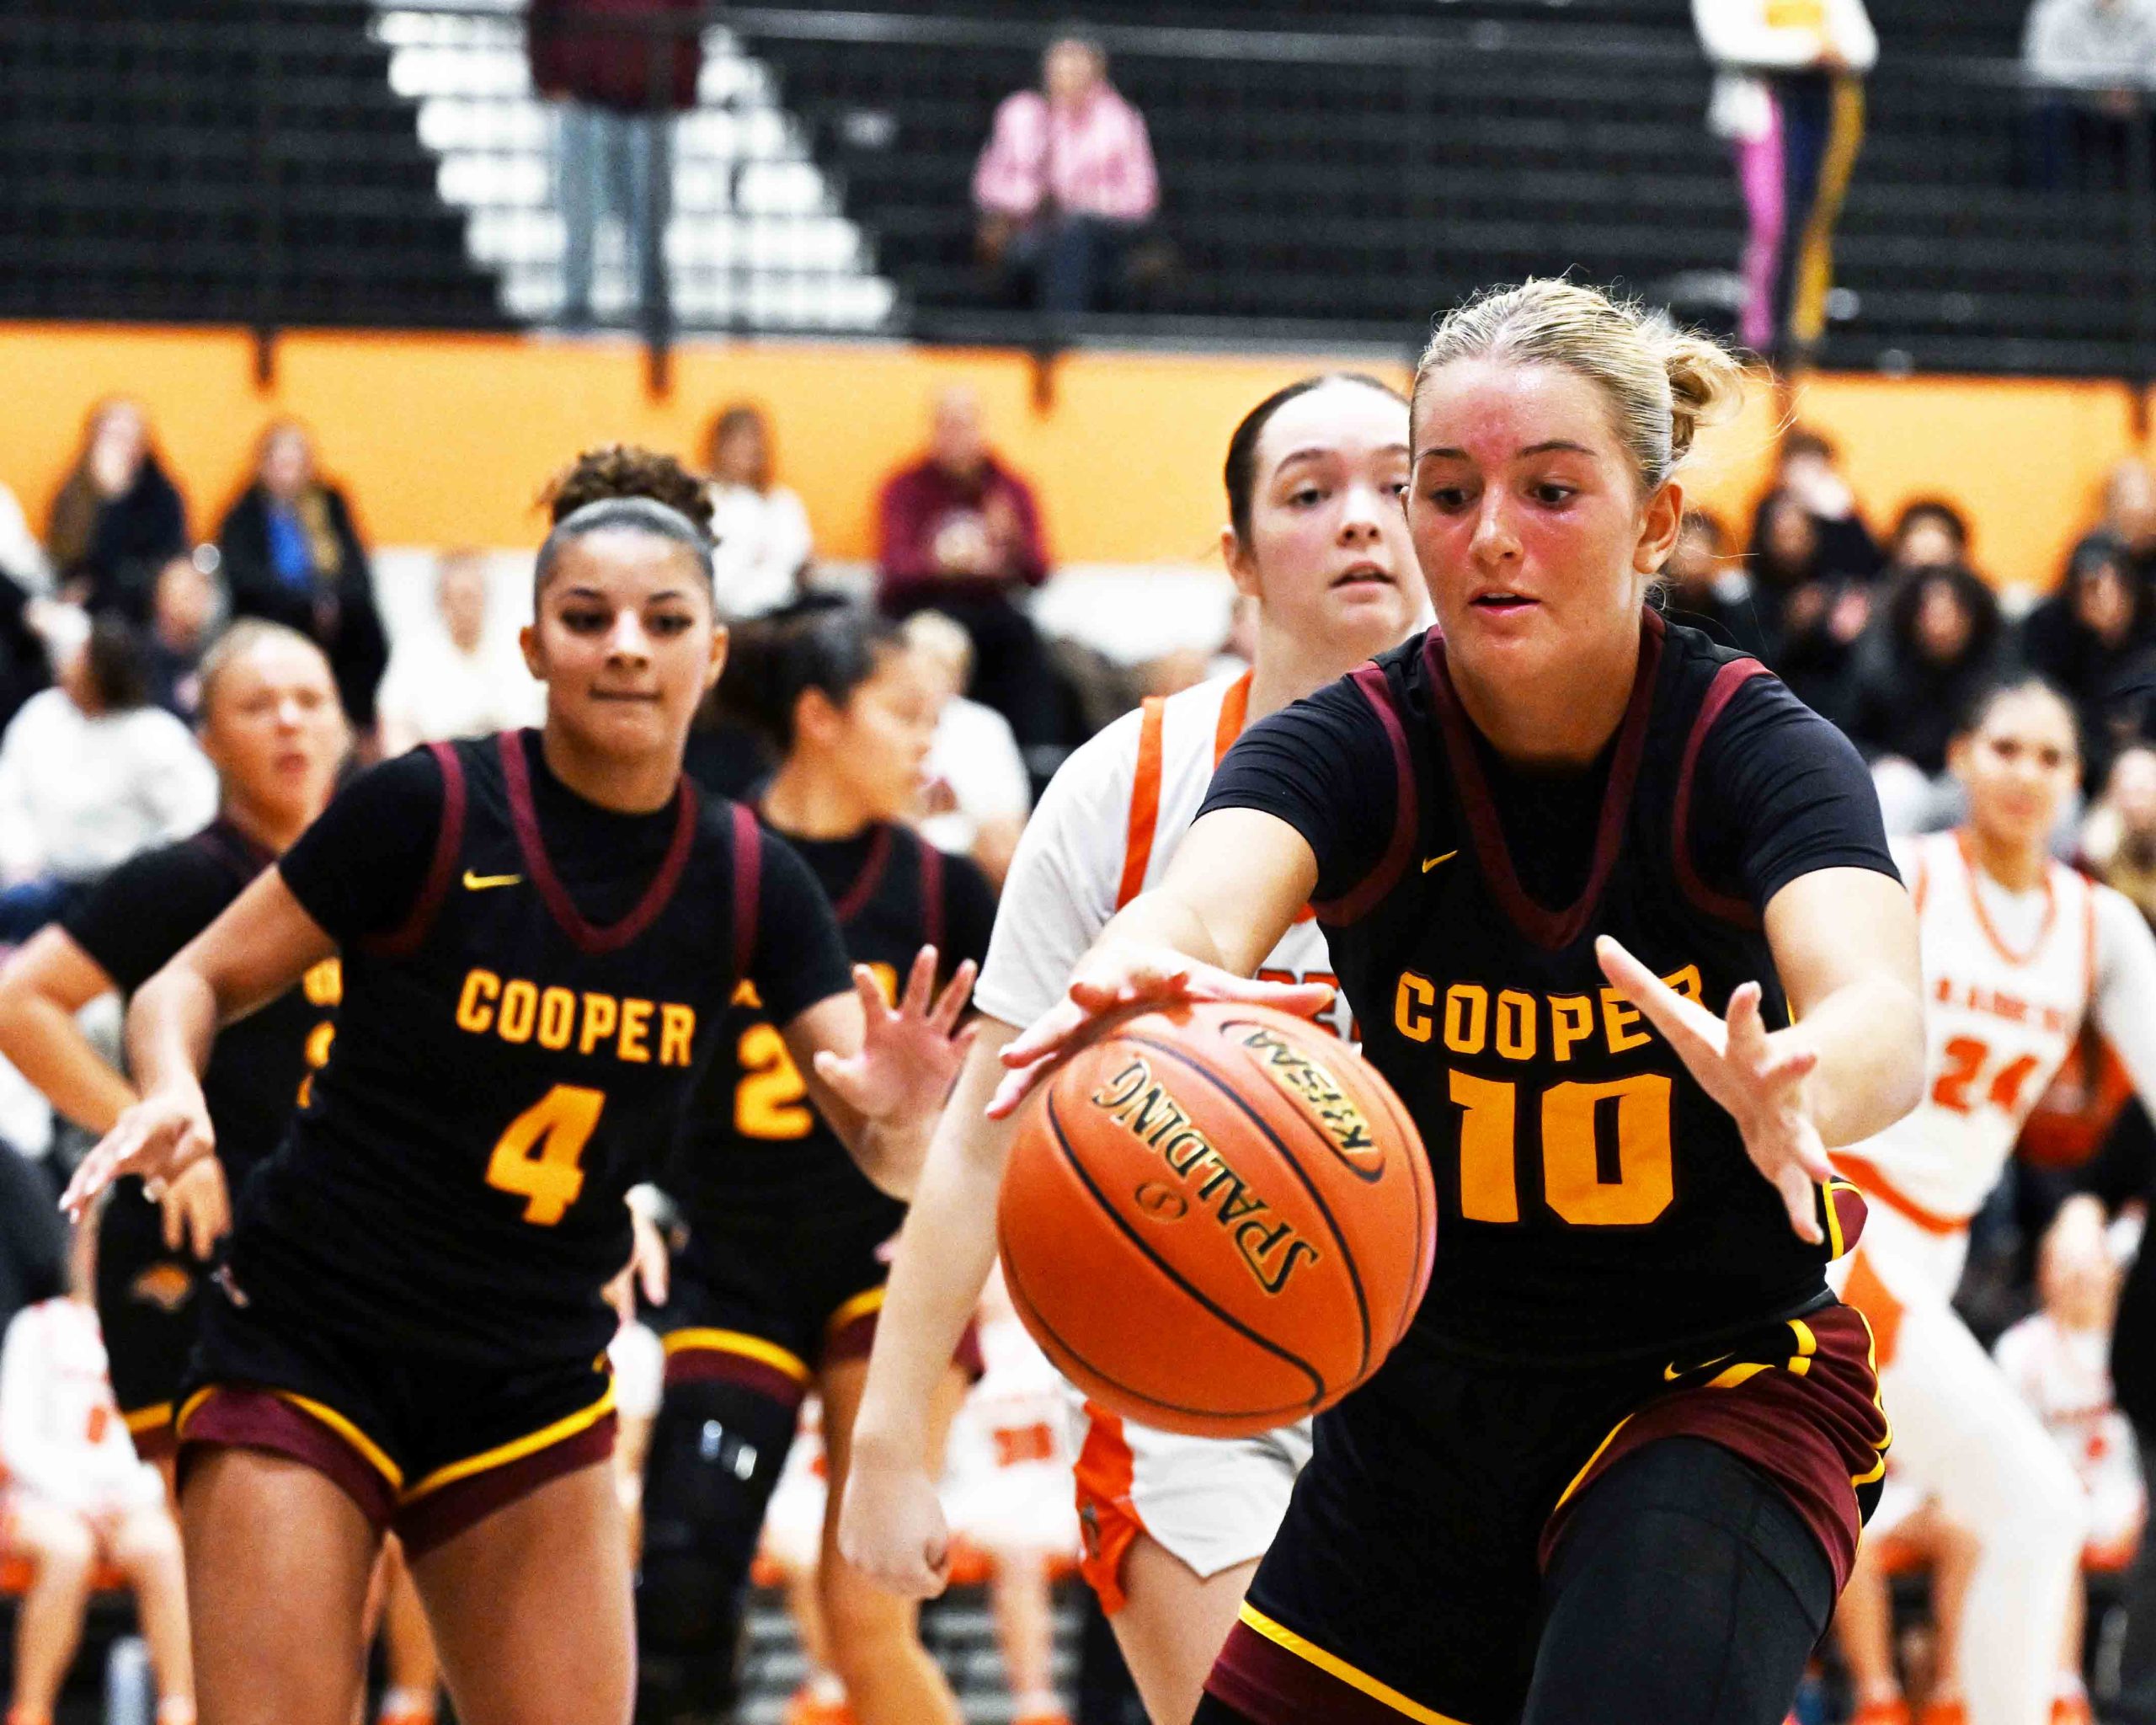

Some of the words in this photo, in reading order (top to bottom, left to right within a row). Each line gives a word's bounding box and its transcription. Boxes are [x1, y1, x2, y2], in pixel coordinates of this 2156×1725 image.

[456, 967, 696, 1067] COOPER
[484, 1081, 607, 1227] 4
[1091, 1058, 1320, 1295] SPALDING
[1448, 1067, 1675, 1226] 10
